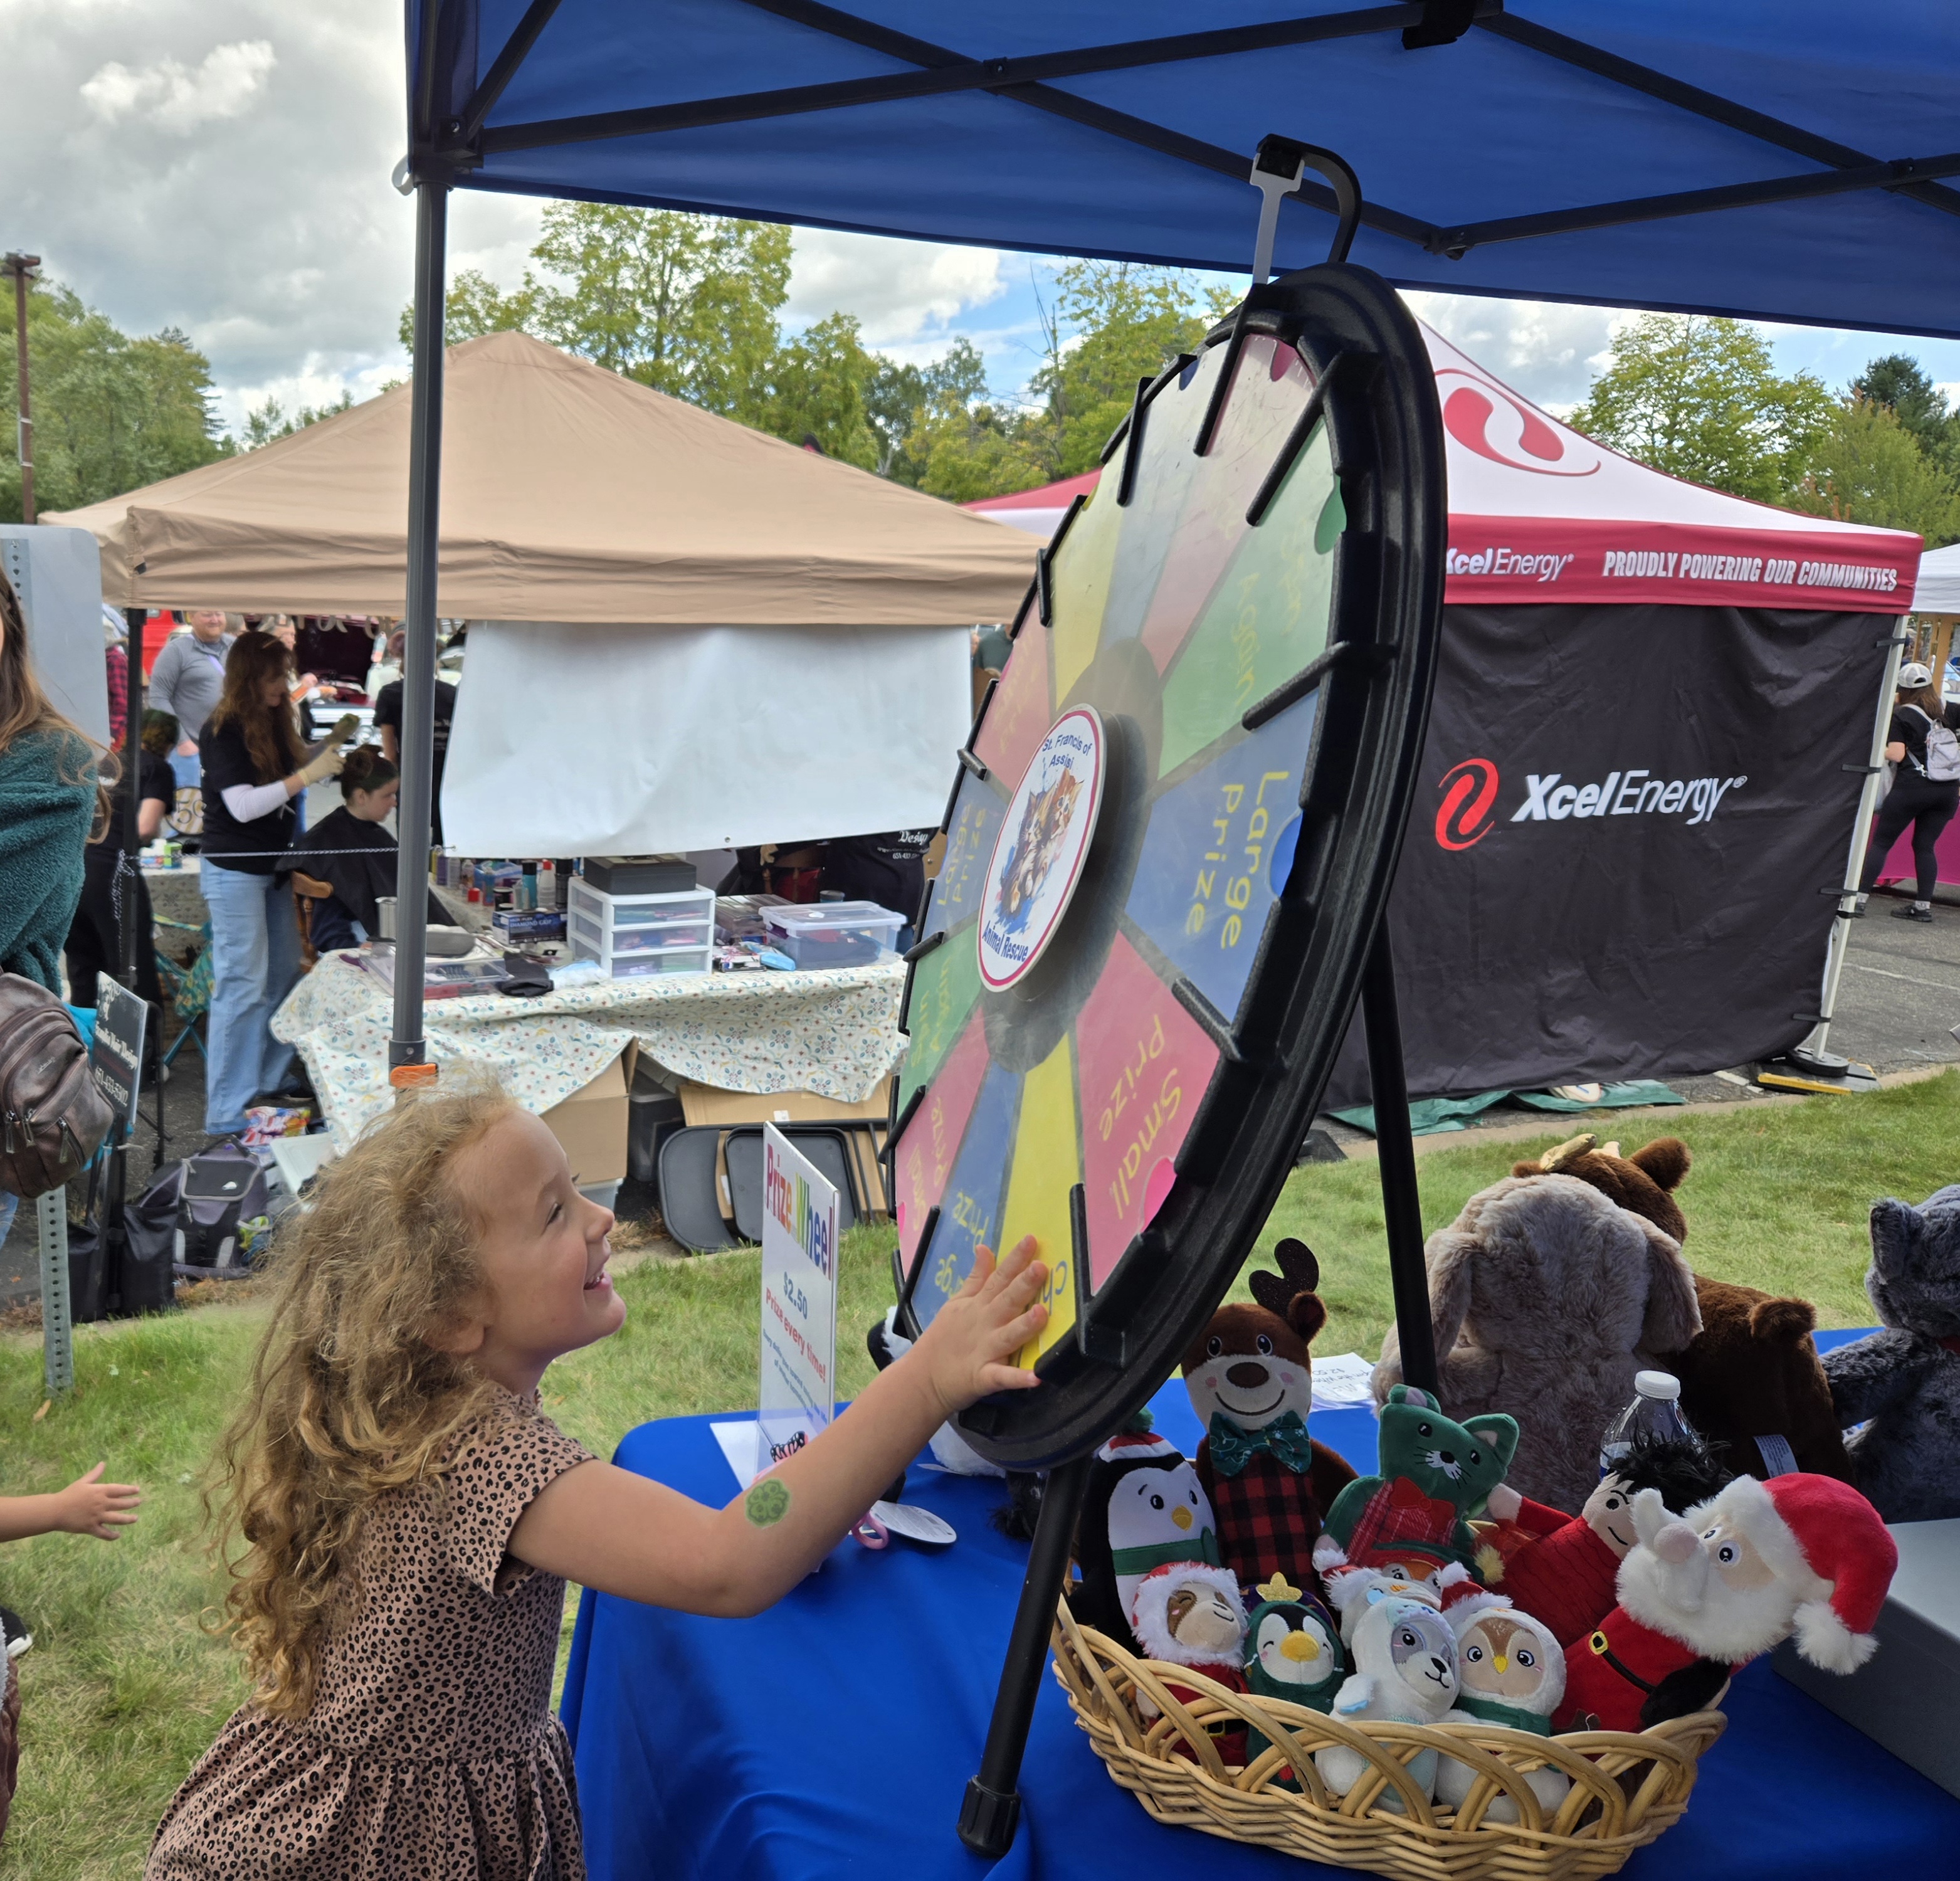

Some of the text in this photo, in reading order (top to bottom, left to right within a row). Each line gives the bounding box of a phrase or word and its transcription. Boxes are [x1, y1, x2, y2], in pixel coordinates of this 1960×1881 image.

[1602, 551, 1678, 577] PROUDLY
[1678, 553, 1762, 582] POWERING
[1763, 558, 1797, 584] OUR
[1796, 561, 1898, 592] COMMUNITIES
[1048, 753, 1075, 770] Assisi
[1054, 734, 1083, 751] Francis
[1082, 742, 1093, 756] of
[937, 803, 971, 906] Large
[1184, 783, 1246, 937] Prize
[1220, 771, 1290, 951] Large
[982, 920, 1029, 962] Animal Rescue
[1109, 1067, 1184, 1220] Small
[766, 1142, 833, 1281] Prize Wheel
[766, 1287, 783, 1322] Prize
[784, 1316, 805, 1356] every
[806, 1342, 826, 1384] time!
[784, 1272, 808, 1320] $2.50
